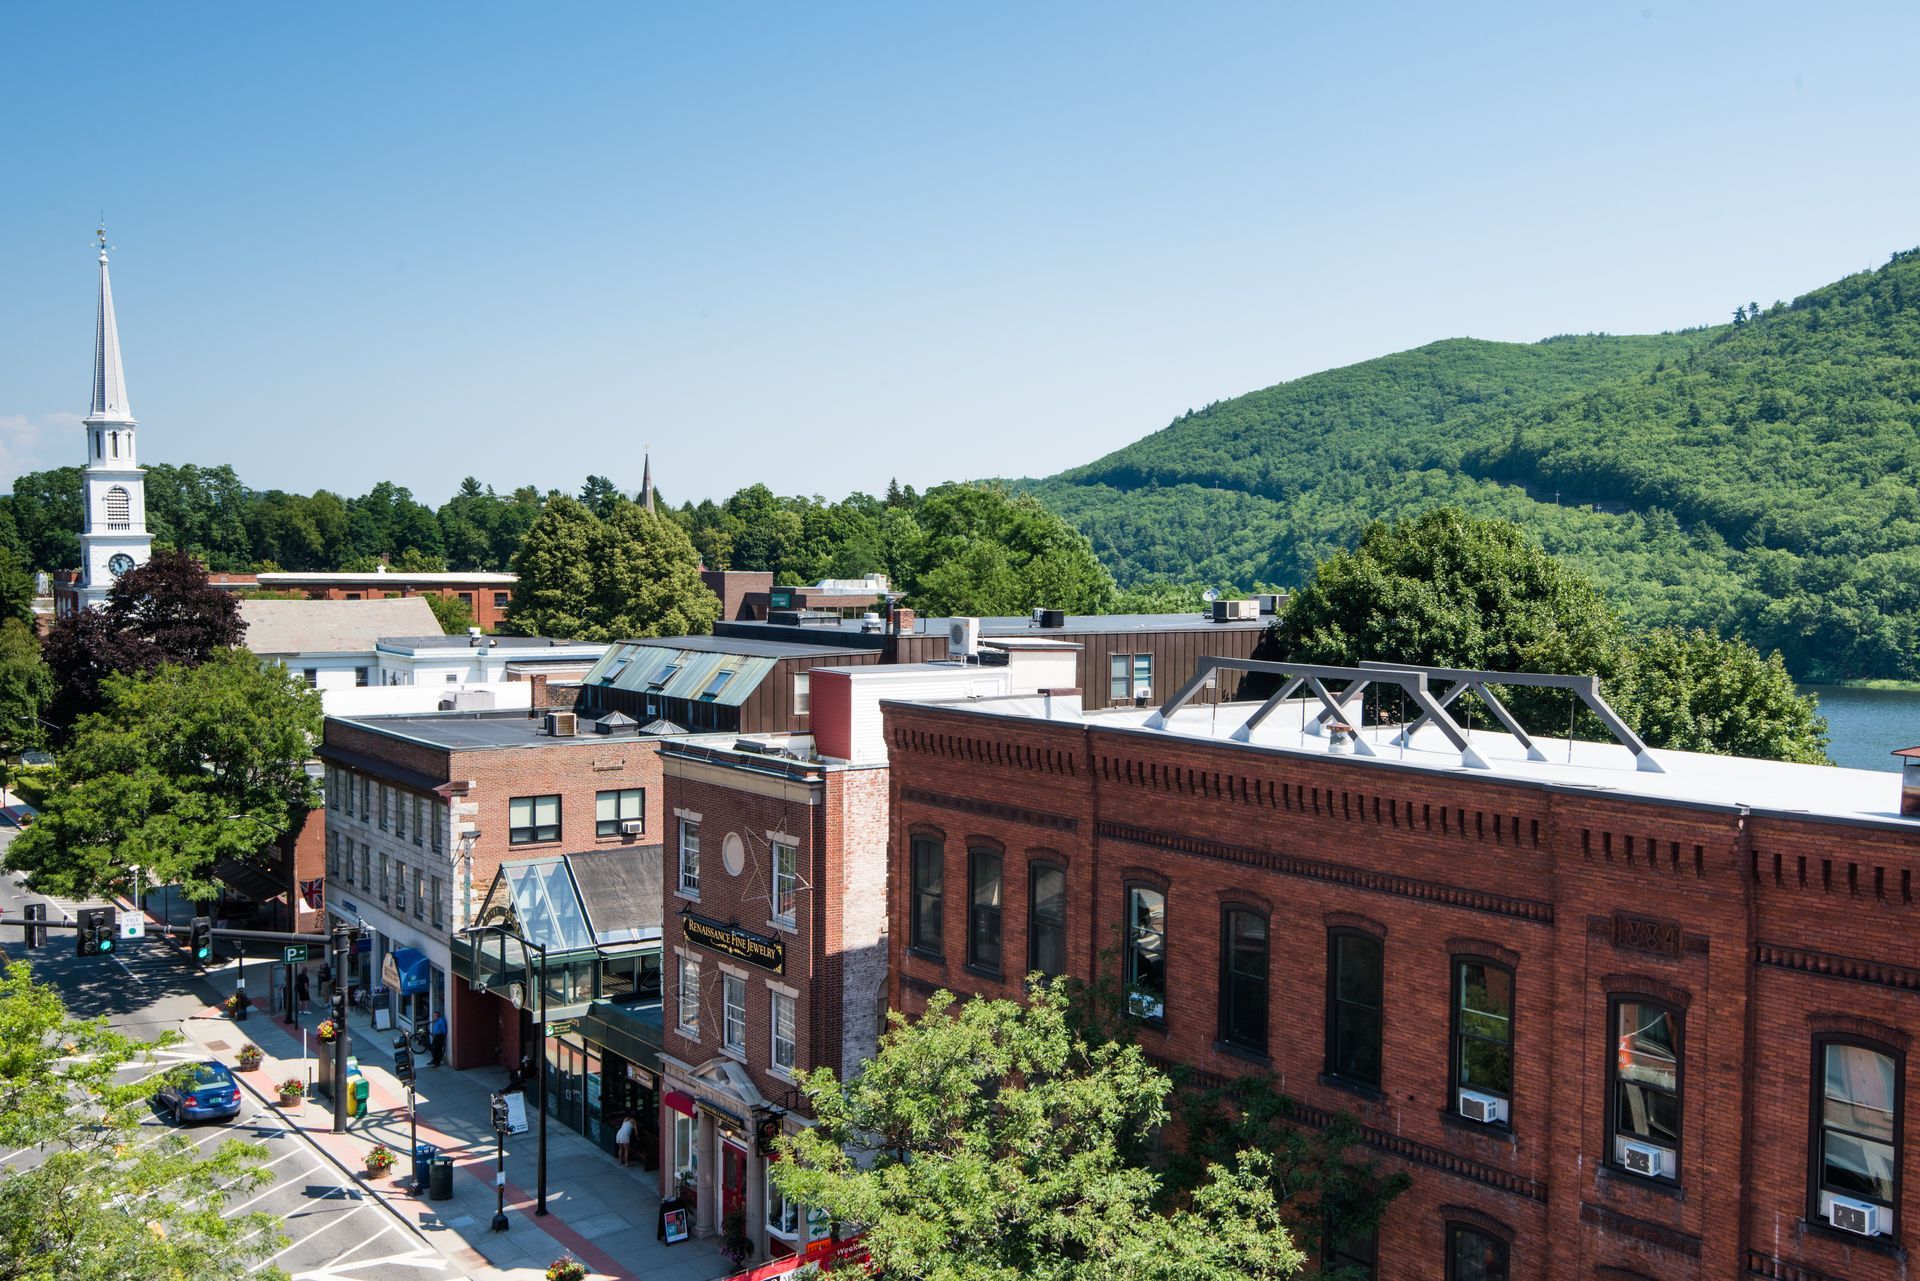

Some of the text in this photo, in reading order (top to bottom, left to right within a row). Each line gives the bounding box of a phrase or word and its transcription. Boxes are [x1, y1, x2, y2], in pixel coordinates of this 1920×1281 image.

[689, 919, 776, 959] RENAISSANCE FINE JEWELRY
[1617, 917, 1677, 953] 1884
